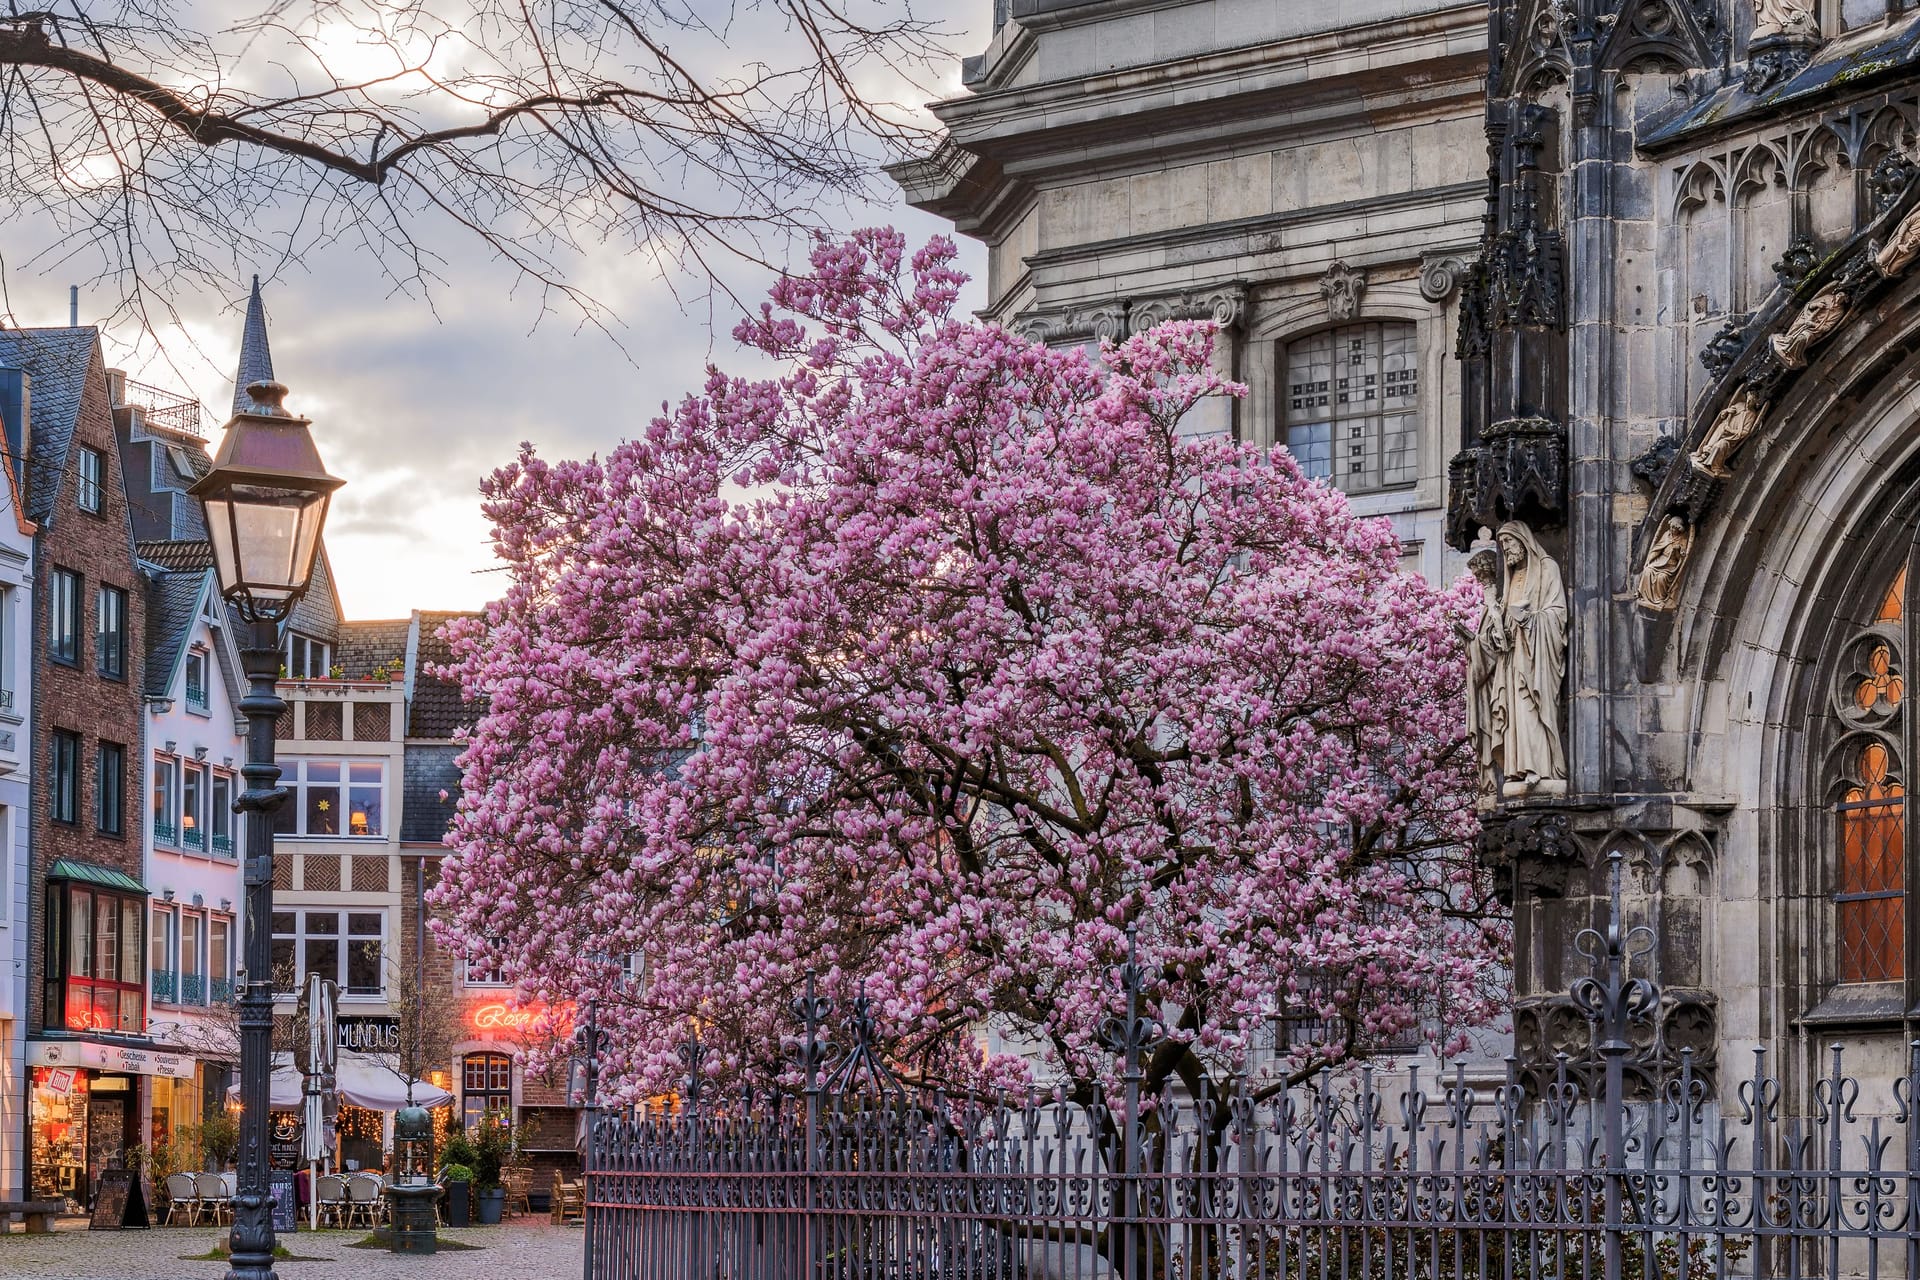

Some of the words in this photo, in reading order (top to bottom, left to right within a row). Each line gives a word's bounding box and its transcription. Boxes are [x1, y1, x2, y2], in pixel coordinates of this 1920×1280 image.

[475, 1005, 530, 1027] Rose
[338, 1024, 399, 1047] MUNDUS
[120, 1050, 147, 1062] Geschenke
[156, 1054, 179, 1066] Souvenirs
[125, 1061, 141, 1072] Tabak
[159, 1064, 175, 1075] Presse
